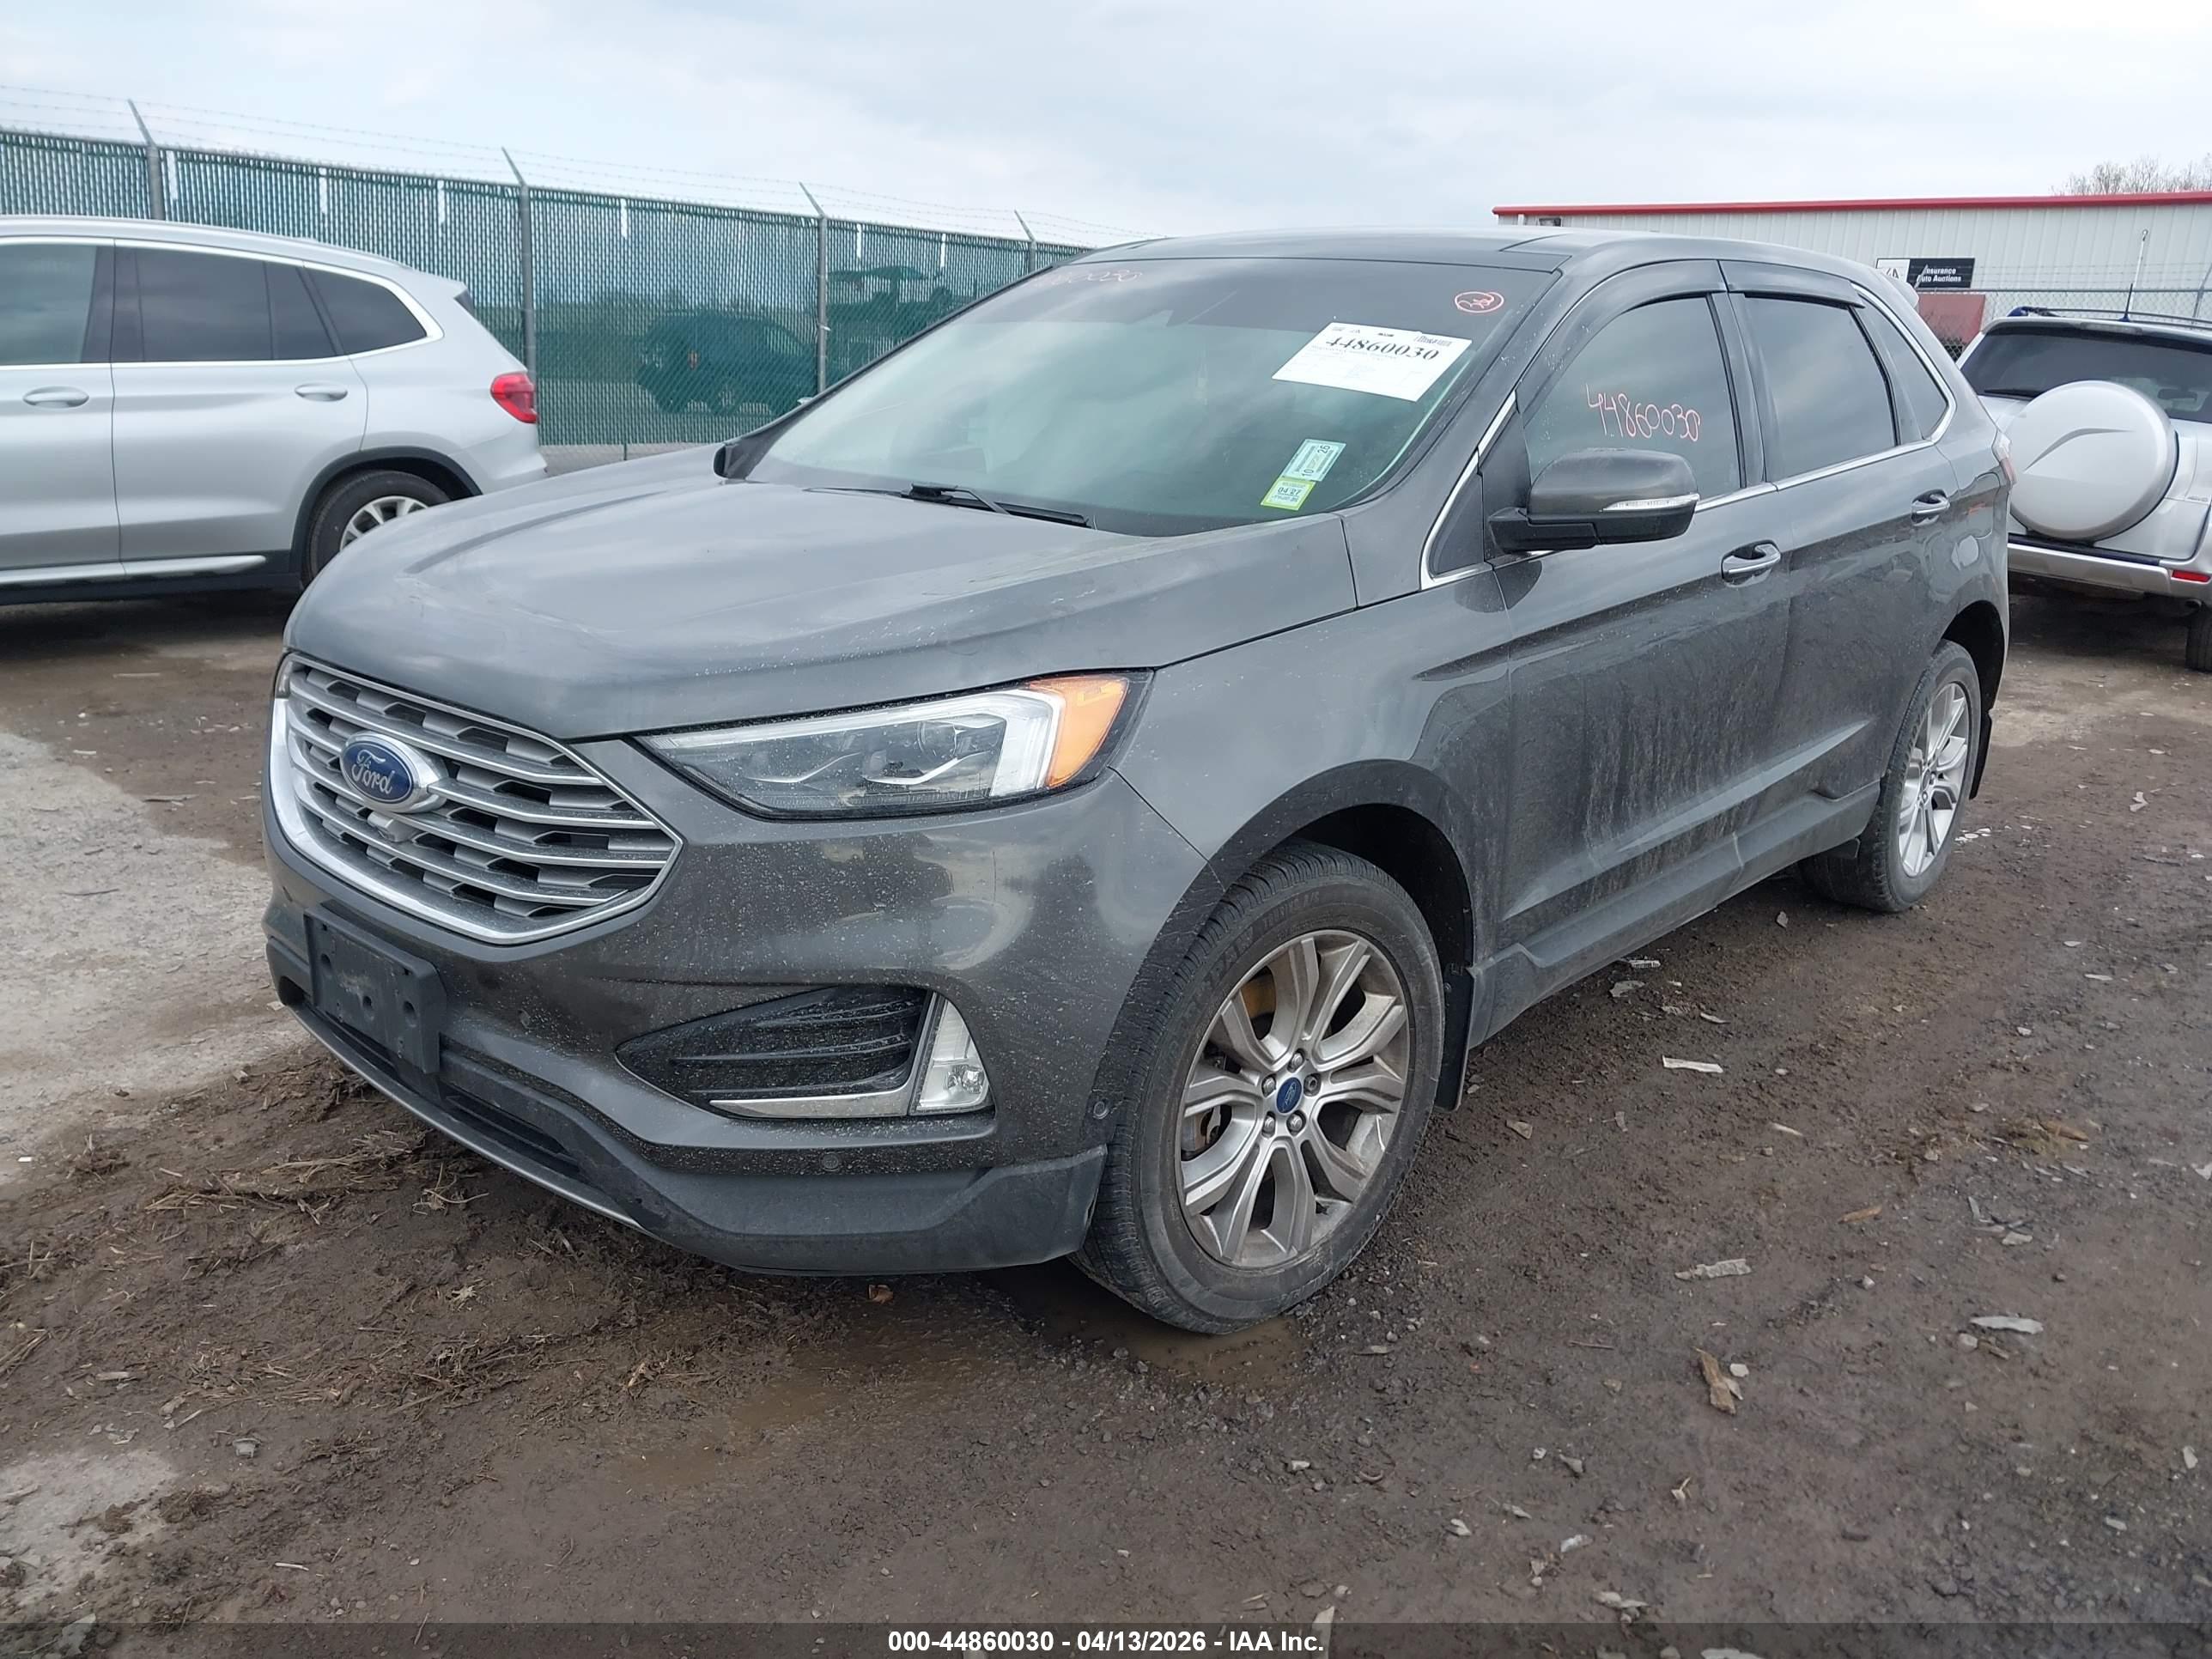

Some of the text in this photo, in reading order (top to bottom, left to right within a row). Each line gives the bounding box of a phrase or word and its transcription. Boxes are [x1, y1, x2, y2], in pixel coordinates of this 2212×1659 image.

[1325, 336, 1440, 361] 44860030
[1585, 382, 1701, 442] 44860030
[351, 749, 396, 795] Ford
